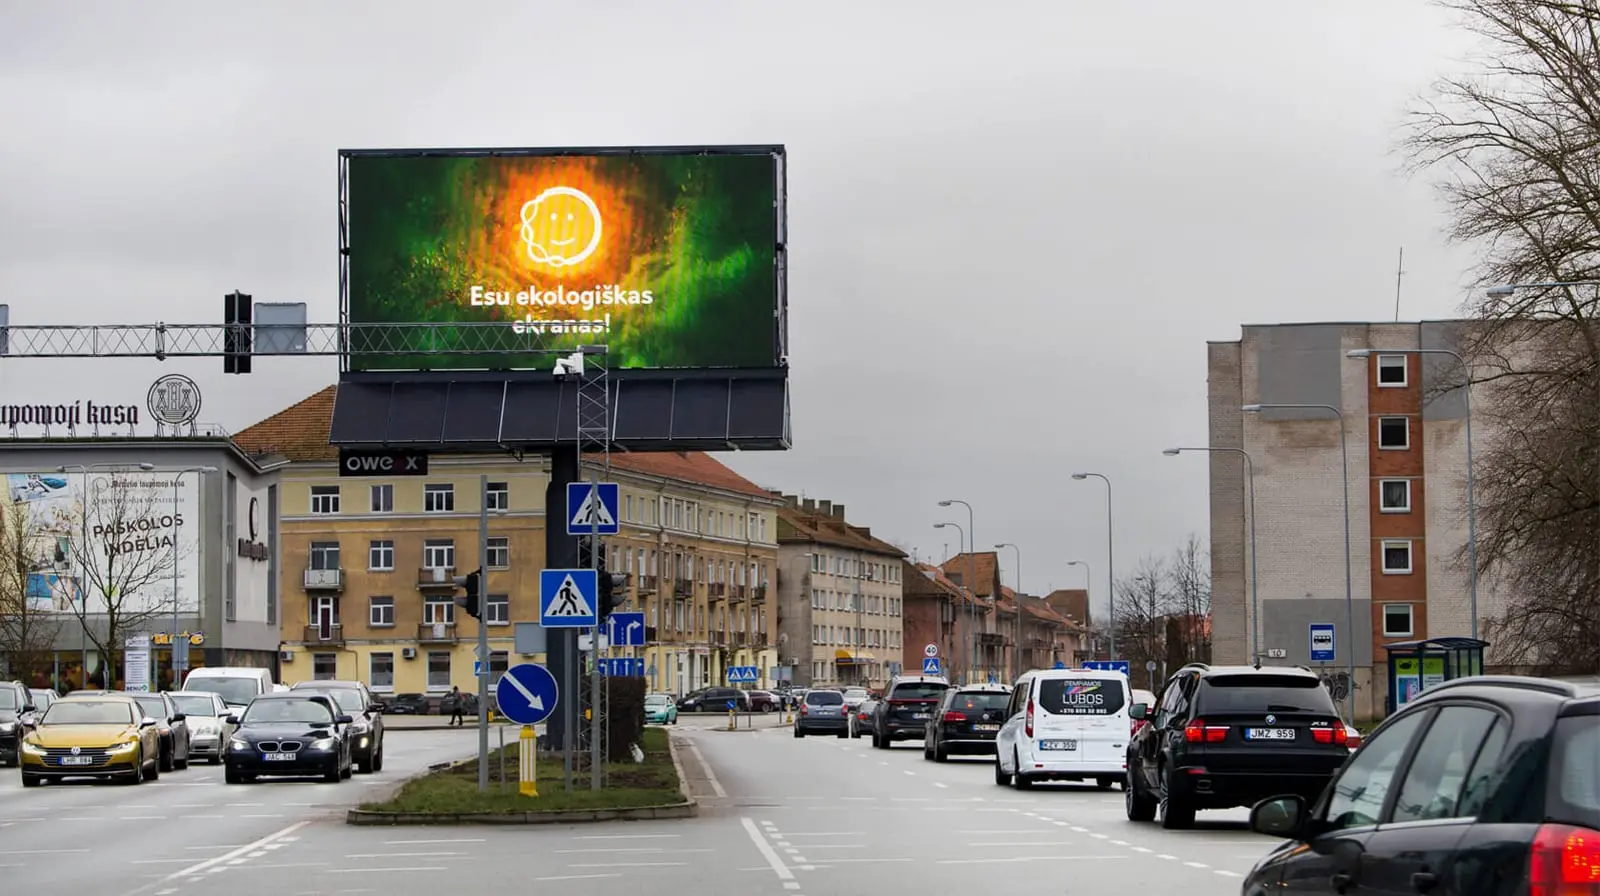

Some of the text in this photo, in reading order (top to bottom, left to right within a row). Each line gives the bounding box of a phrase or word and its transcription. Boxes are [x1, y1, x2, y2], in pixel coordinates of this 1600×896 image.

[470, 284, 653, 311] Esu ekologiškas
[512, 313, 611, 335] ekranas!
[87, 400, 139, 425] kasa
[346, 456, 418, 471] owex
[93, 513, 184, 539] PASKOLOS
[1062, 693, 1104, 705] LUBOS
[1251, 728, 1294, 738] JMZ 959
